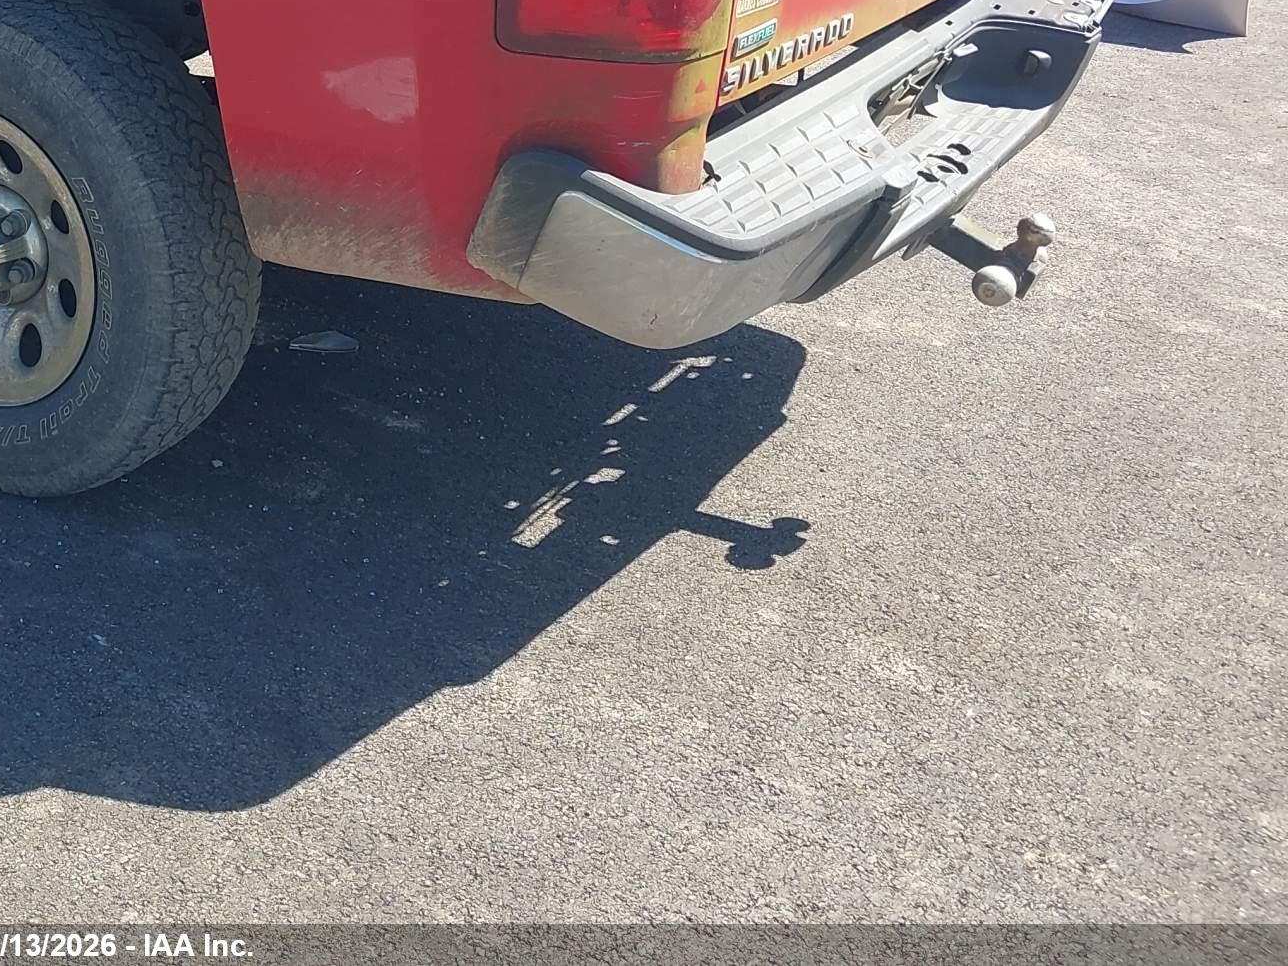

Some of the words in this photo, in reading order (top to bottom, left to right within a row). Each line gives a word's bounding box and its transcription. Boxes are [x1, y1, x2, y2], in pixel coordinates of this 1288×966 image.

[722, 12, 854, 94] SILVERADO
[71, 176, 113, 365] Rugged
[39, 366, 103, 440] Trail
